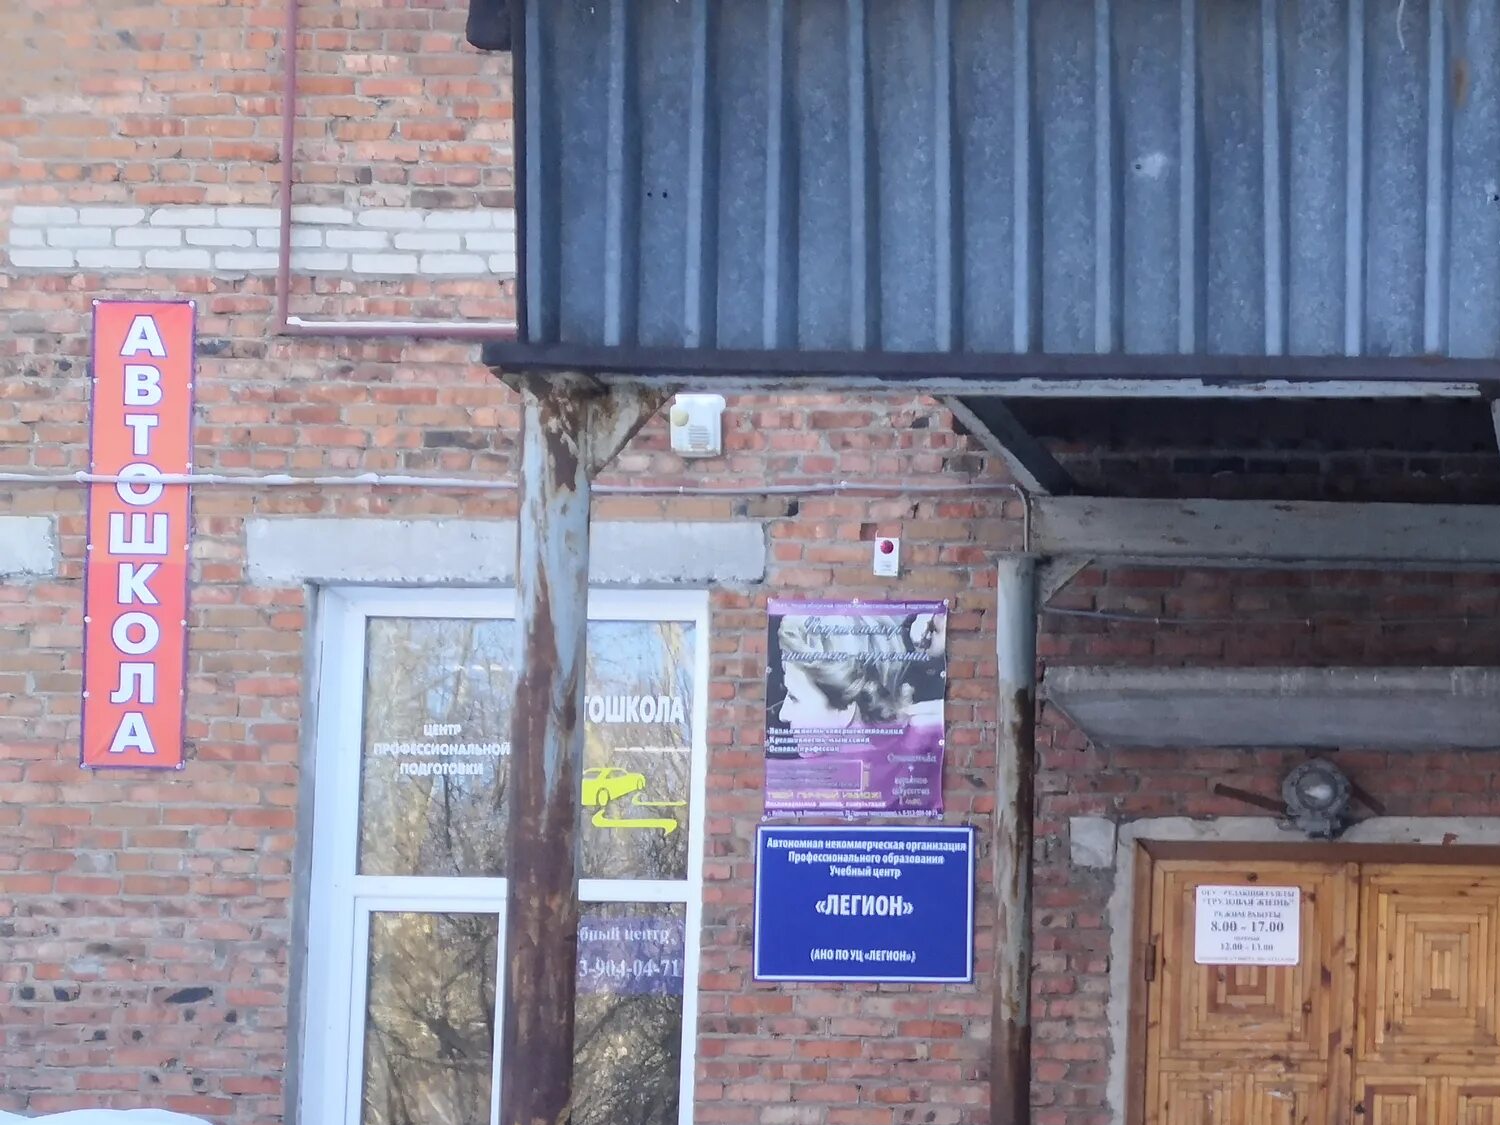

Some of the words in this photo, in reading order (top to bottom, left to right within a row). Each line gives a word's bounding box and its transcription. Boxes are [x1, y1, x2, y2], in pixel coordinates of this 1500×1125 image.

[108, 314, 169, 754] АВТОШКОЛА
[423, 723, 462, 738] ЦЕНТР
[373, 741, 511, 756] ПРОФЕССИОНАЛЬНОЙ
[399, 761, 483, 776] ПОДГОТОВКИ
[766, 837, 824, 849] Автономная
[825, 838, 905, 853] некоммерческая
[905, 840, 967, 853] организация
[788, 851, 881, 865] Профессионального
[882, 852, 945, 865] образования
[829, 864, 871, 878] Учебный
[872, 866, 902, 879] центр
[815, 894, 914, 916] «ЛЕГИОН»
[1210, 921, 1237, 932] 8.00
[1251, 921, 1284, 932] 17.00
[810, 948, 834, 962] (АНО
[835, 949, 849, 961] ПО
[850, 949, 864, 963] УЦ
[864, 950, 916, 964] «ЛЕГИОН»)
